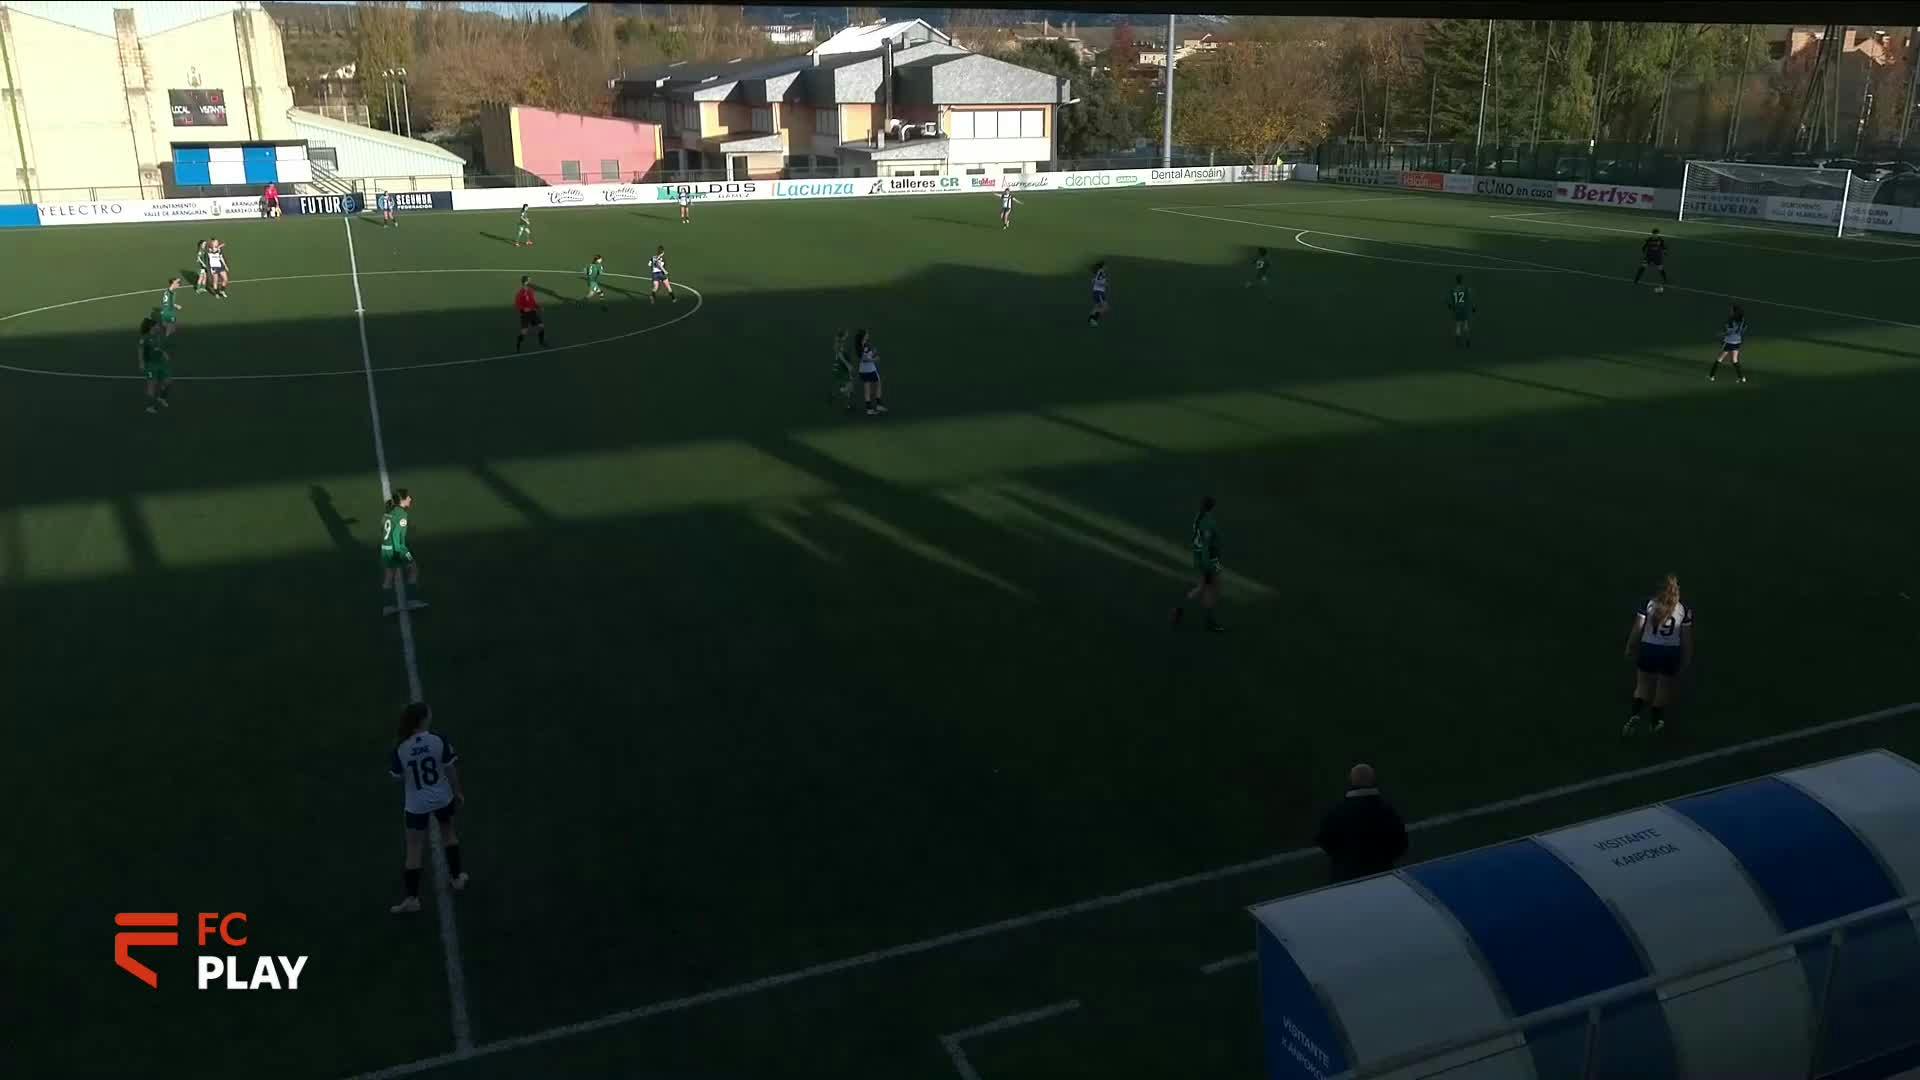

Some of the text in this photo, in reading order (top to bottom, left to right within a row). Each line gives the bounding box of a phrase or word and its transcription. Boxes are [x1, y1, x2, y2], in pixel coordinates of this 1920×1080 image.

[1065, 174, 1110, 187] denda
[1151, 169, 1182, 180] Dental
[776, 182, 854, 197] Lacunza
[890, 177, 960, 190] talleres CR
[396, 194, 433, 205] SEGUNDA
[1571, 184, 1638, 205] Berlys
[1453, 291, 1465, 304] 12
[383, 519, 392, 541] 9
[407, 757, 440, 791] 18
[1593, 827, 1662, 851] VISITANTE
